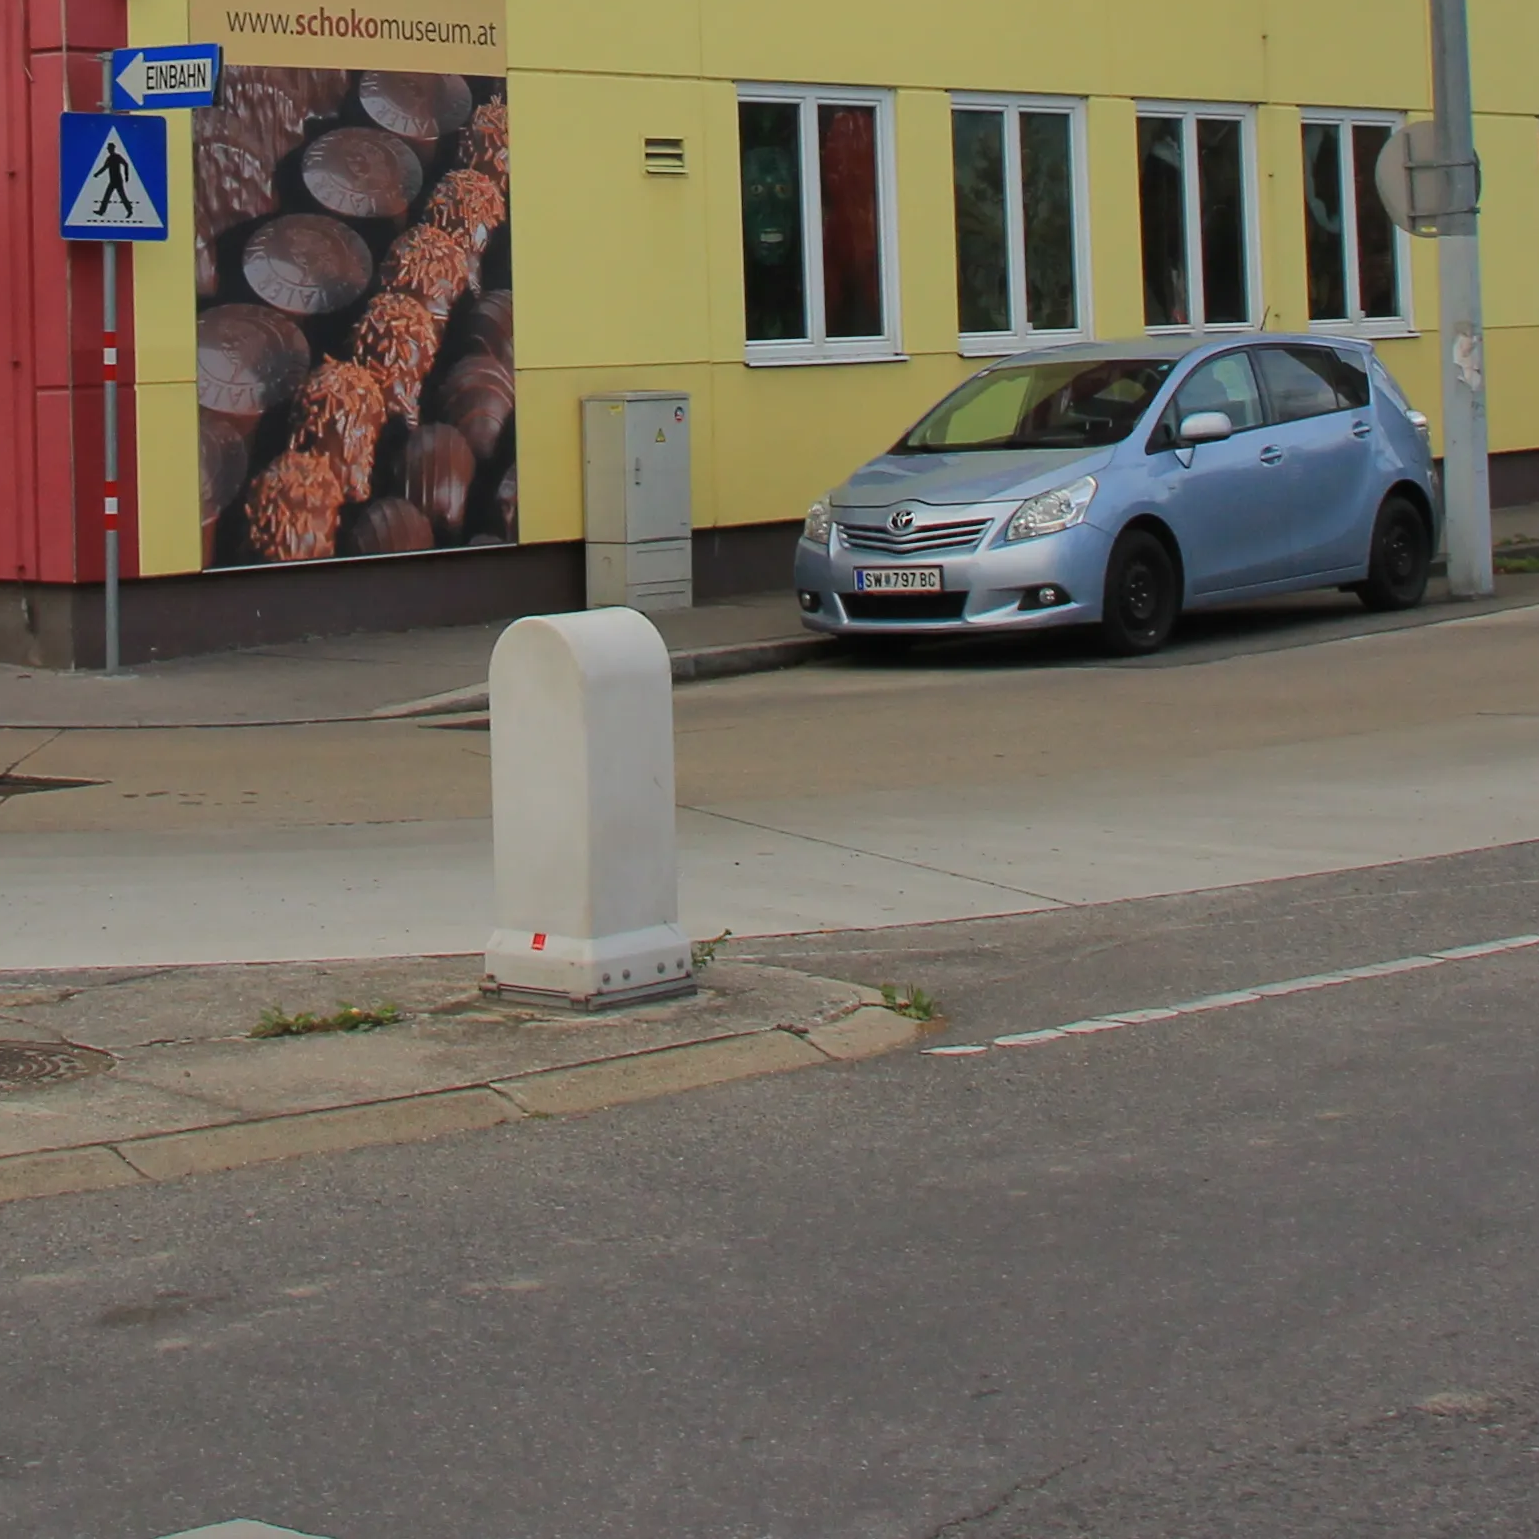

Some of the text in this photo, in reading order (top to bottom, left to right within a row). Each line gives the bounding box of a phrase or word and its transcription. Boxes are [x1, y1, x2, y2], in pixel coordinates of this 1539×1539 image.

[226, 6, 497, 48] www.schokomuseum.at
[145, 62, 207, 91] EINBAHN
[865, 571, 936, 588] SW 797 BC
